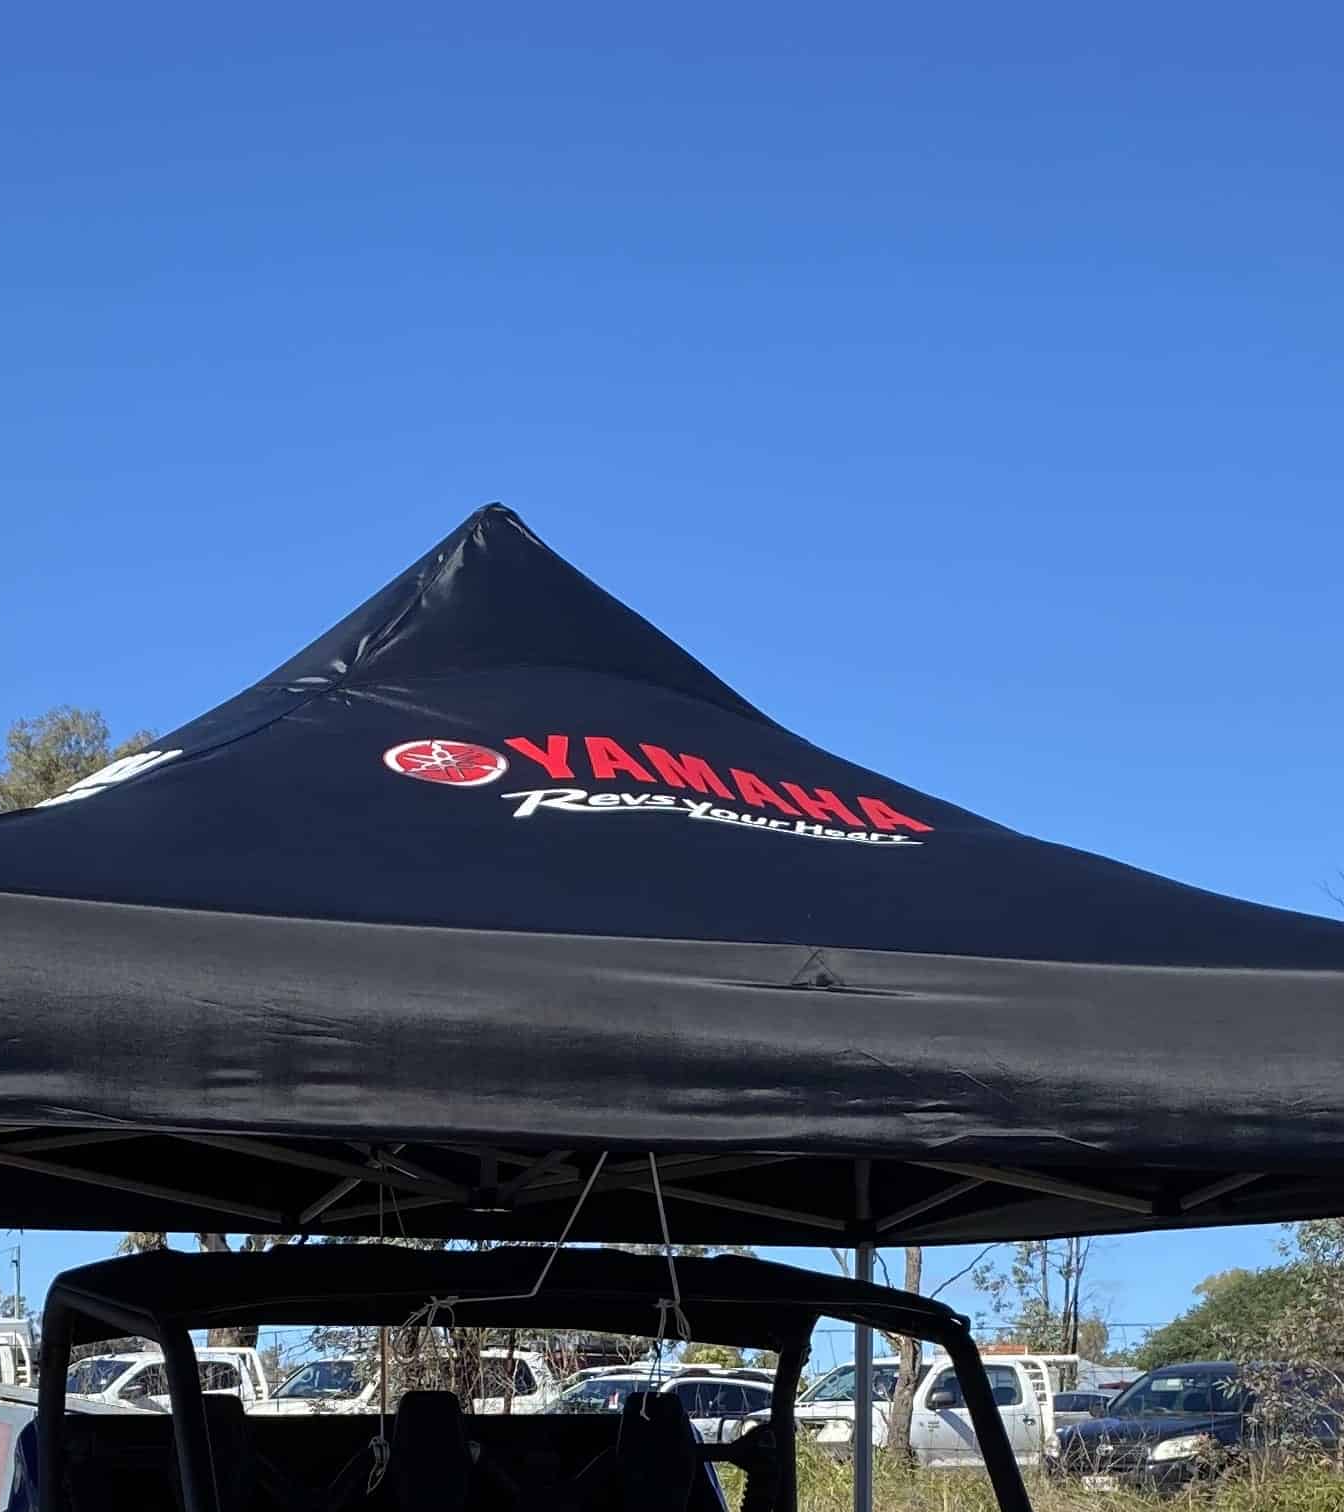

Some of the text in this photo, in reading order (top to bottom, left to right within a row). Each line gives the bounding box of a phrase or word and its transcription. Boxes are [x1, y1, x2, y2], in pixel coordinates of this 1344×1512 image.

[500, 788, 910, 842] Revs Your Heart
[504, 735, 934, 832] YAMAHA
